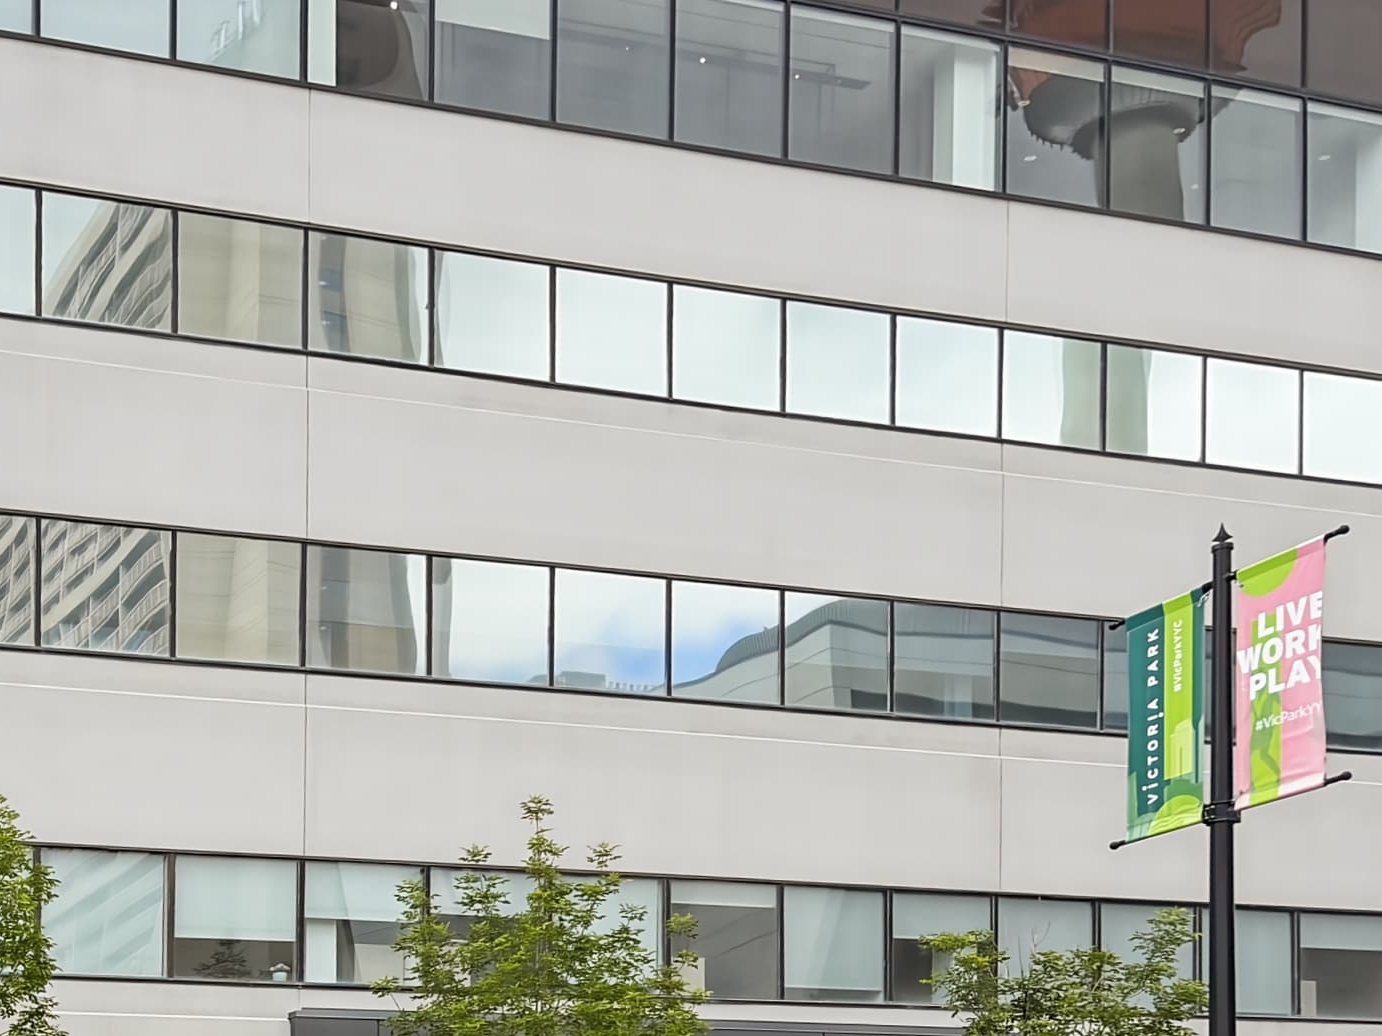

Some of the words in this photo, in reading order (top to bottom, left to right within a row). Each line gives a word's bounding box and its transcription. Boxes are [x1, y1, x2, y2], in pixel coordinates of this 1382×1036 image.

[1258, 590, 1323, 639] LIVE
[1147, 628, 1159, 687] PARK
[1249, 655, 1322, 701] PLAY
